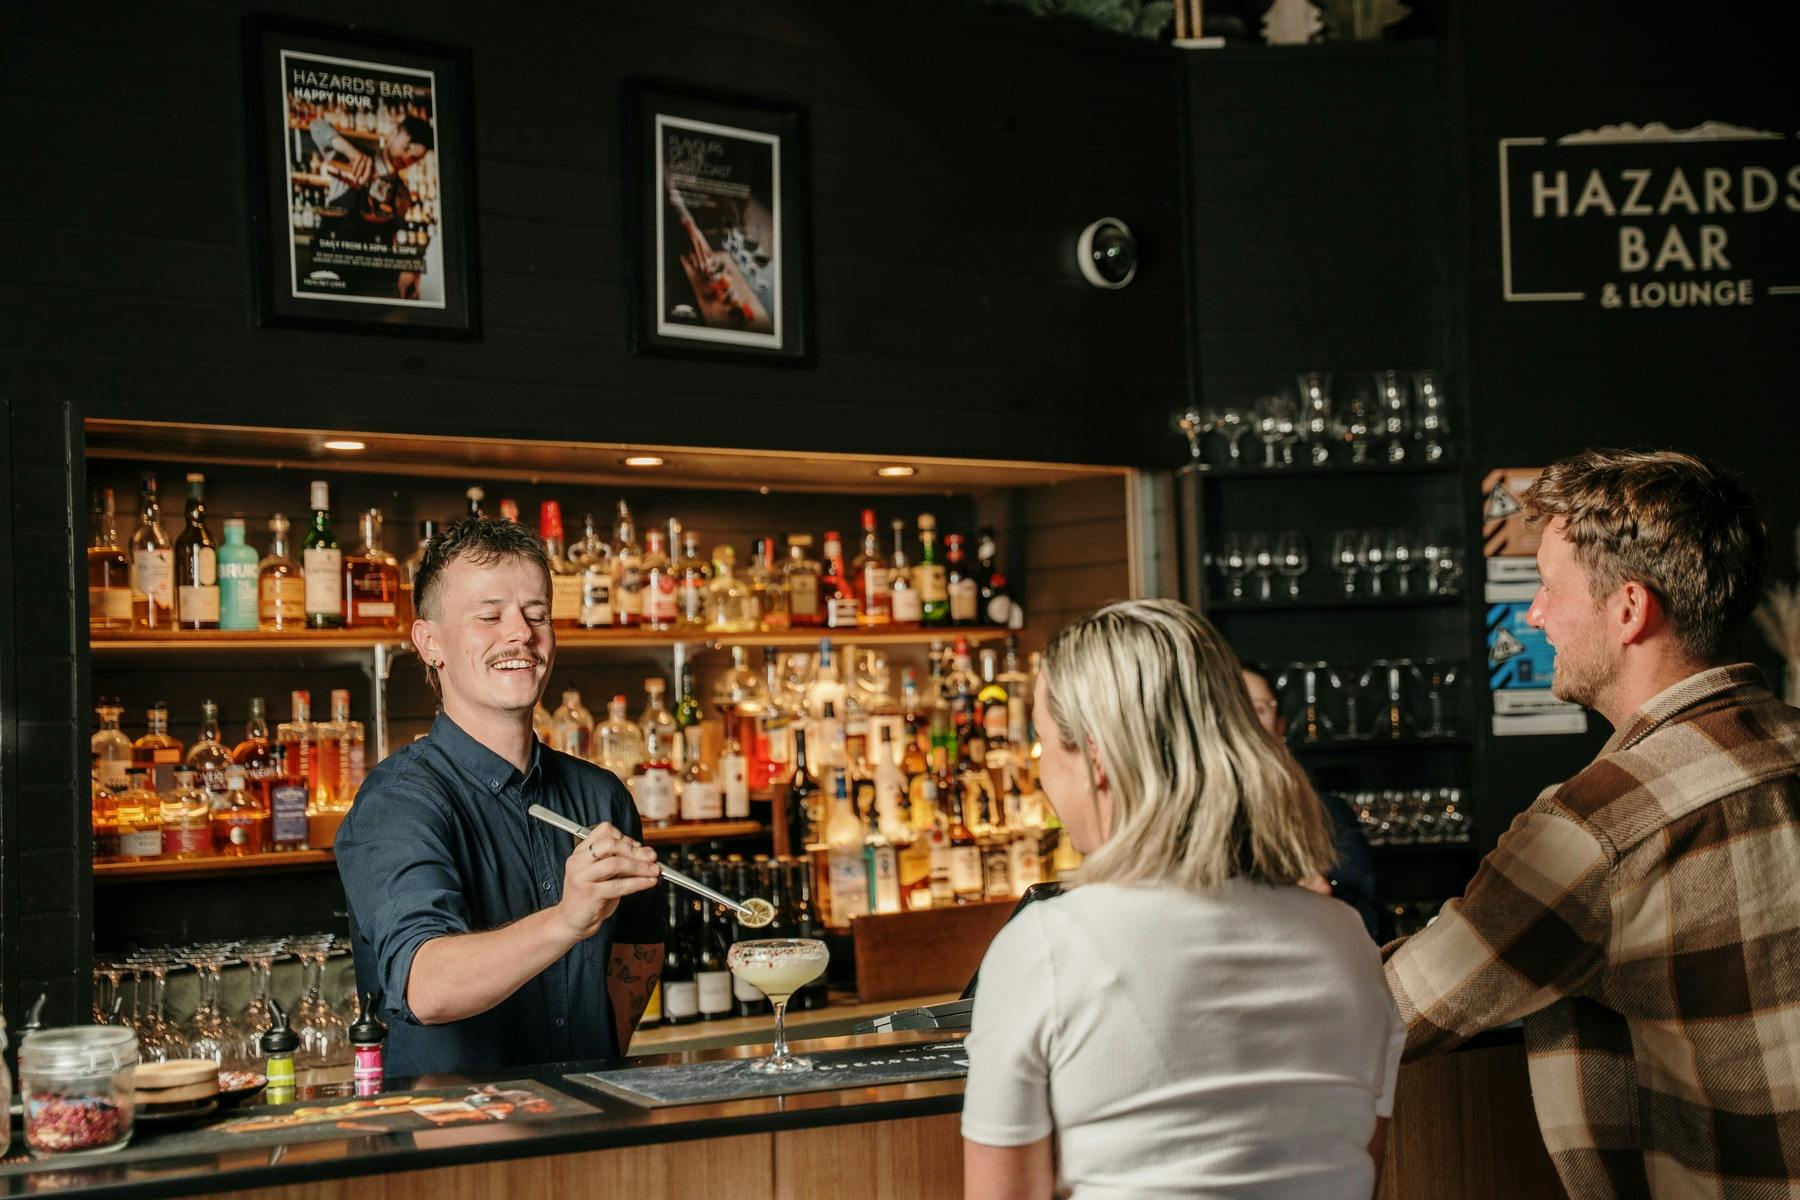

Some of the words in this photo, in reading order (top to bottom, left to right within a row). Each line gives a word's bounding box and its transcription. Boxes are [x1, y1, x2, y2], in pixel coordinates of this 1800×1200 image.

[293, 69, 375, 95] HAZARDS
[380, 81, 416, 100] BAR
[293, 86, 334, 102] HAPPY
[337, 92, 372, 109] HOUR
[1532, 165, 1800, 219] HAZARDS
[1619, 223, 1732, 273] BAR
[1600, 282, 1622, 309] &
[1629, 279, 1754, 309] LOUNGE
